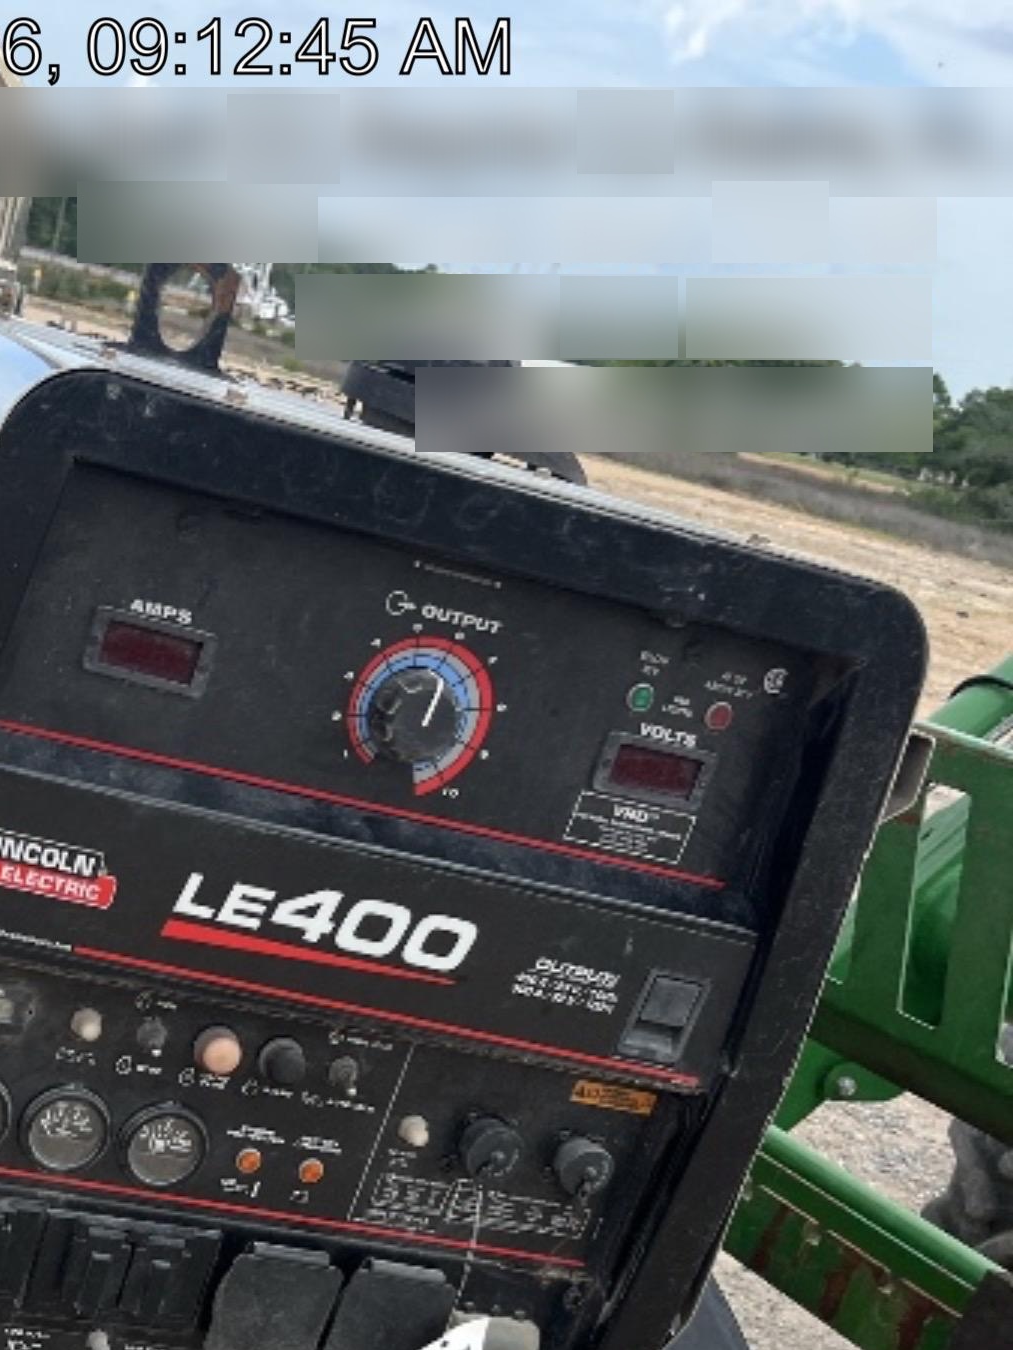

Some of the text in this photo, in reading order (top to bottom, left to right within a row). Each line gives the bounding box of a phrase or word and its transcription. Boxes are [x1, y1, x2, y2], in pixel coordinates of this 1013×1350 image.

[130, 599, 193, 625] AMPS
[421, 604, 504, 635] OUTPUT
[640, 721, 697, 748] VOLTS
[172, 871, 479, 973] LE400
